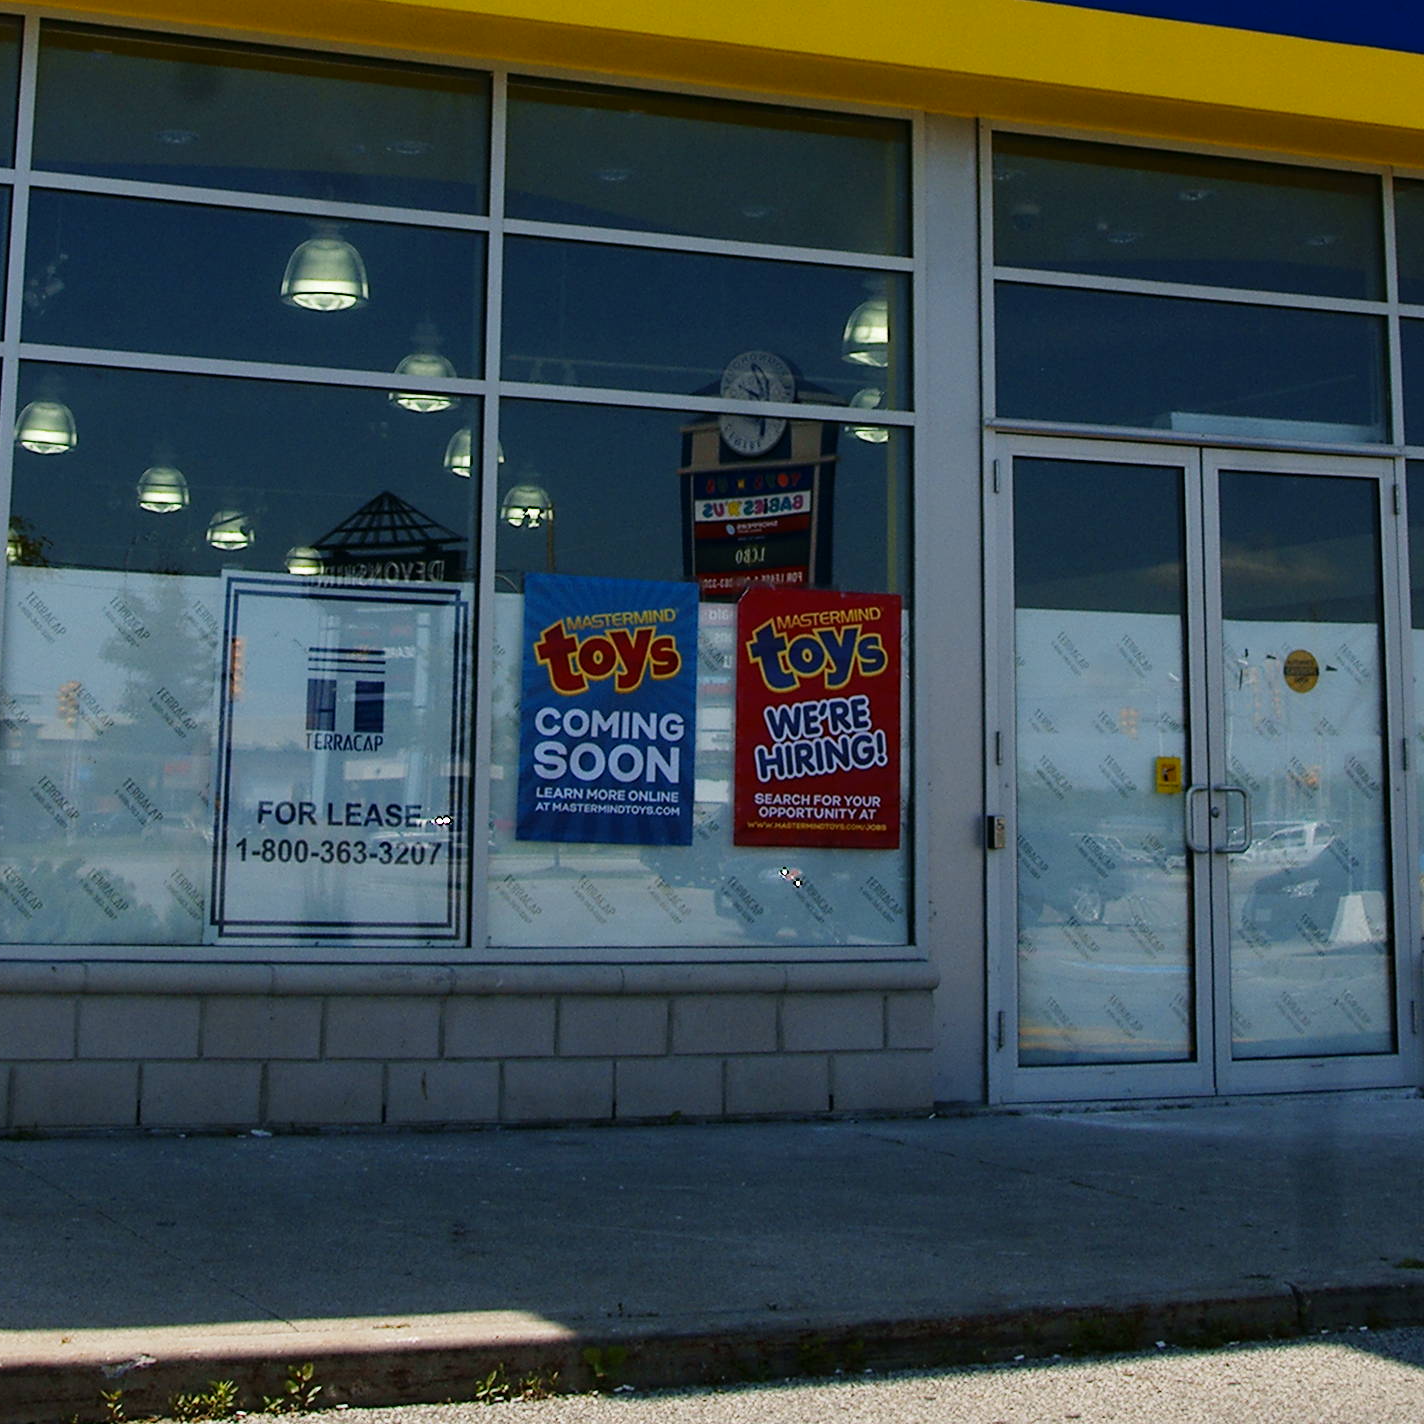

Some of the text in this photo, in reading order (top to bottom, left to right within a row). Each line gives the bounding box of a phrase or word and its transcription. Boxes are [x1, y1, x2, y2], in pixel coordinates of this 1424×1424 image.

[566, 608, 677, 631] MASTERMIND
[776, 607, 882, 630] MASTERMIND
[533, 619, 682, 696] toys
[745, 617, 889, 694] toys
[534, 706, 685, 742] COMING
[763, 694, 872, 744] WE'RE
[306, 733, 384, 752] TERRACAP
[754, 730, 889, 783] HIRING!
[533, 740, 680, 784] SOON
[536, 786, 679, 804] LEARN MORE ONLINE
[754, 792, 881, 809] SEARCH FOR YOUR
[257, 800, 422, 828] FOR LEASE
[535, 802, 681, 817] AT MASTERMINDTOYS.COM
[758, 805, 877, 821] OPPORTUNITY AT
[236, 837, 443, 866] 1-800-363-3207
